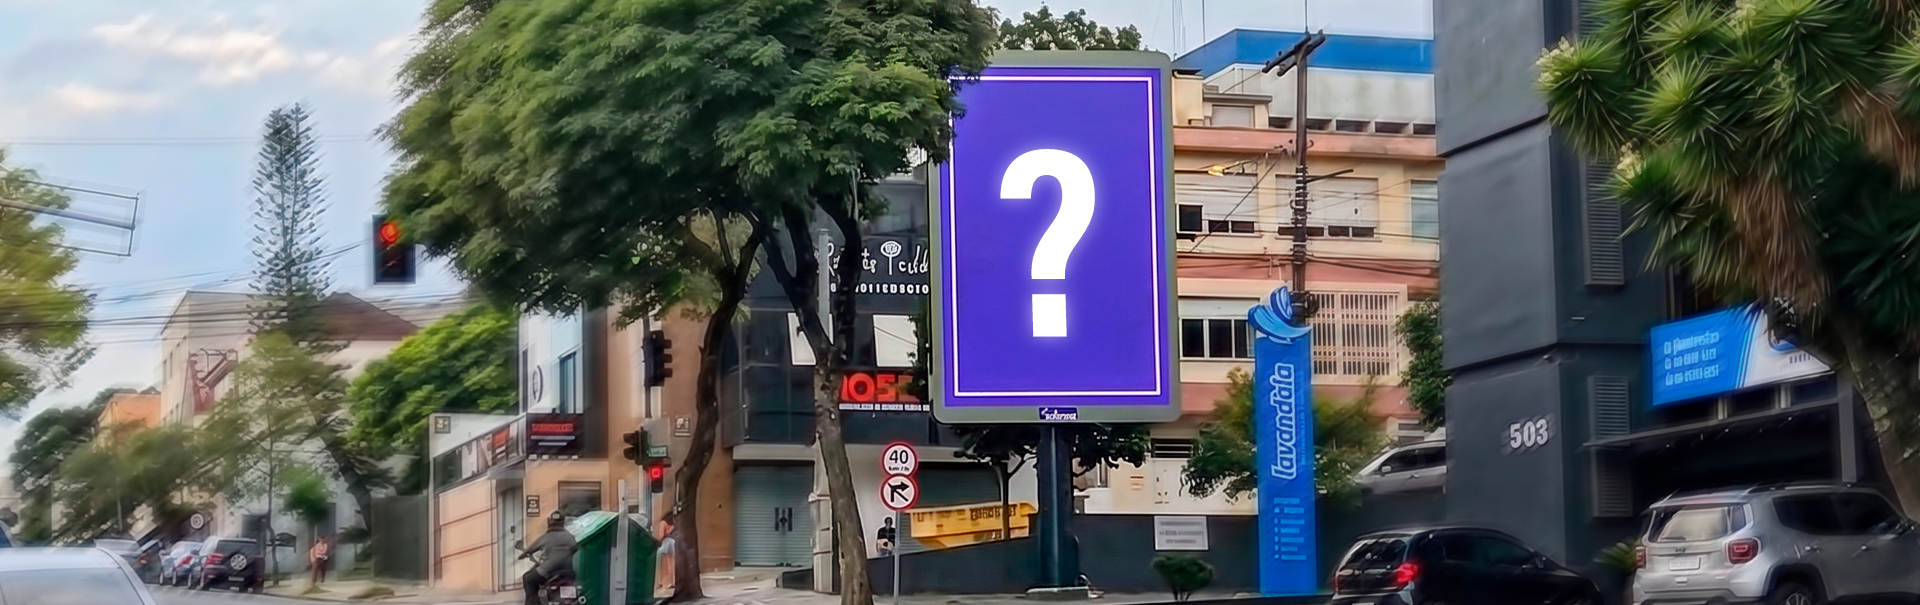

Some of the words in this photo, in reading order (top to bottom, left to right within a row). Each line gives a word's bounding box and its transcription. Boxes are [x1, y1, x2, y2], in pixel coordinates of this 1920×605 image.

[1000, 149, 1095, 337] ?
[1510, 418, 1548, 449] 503
[889, 450, 909, 464] 40
